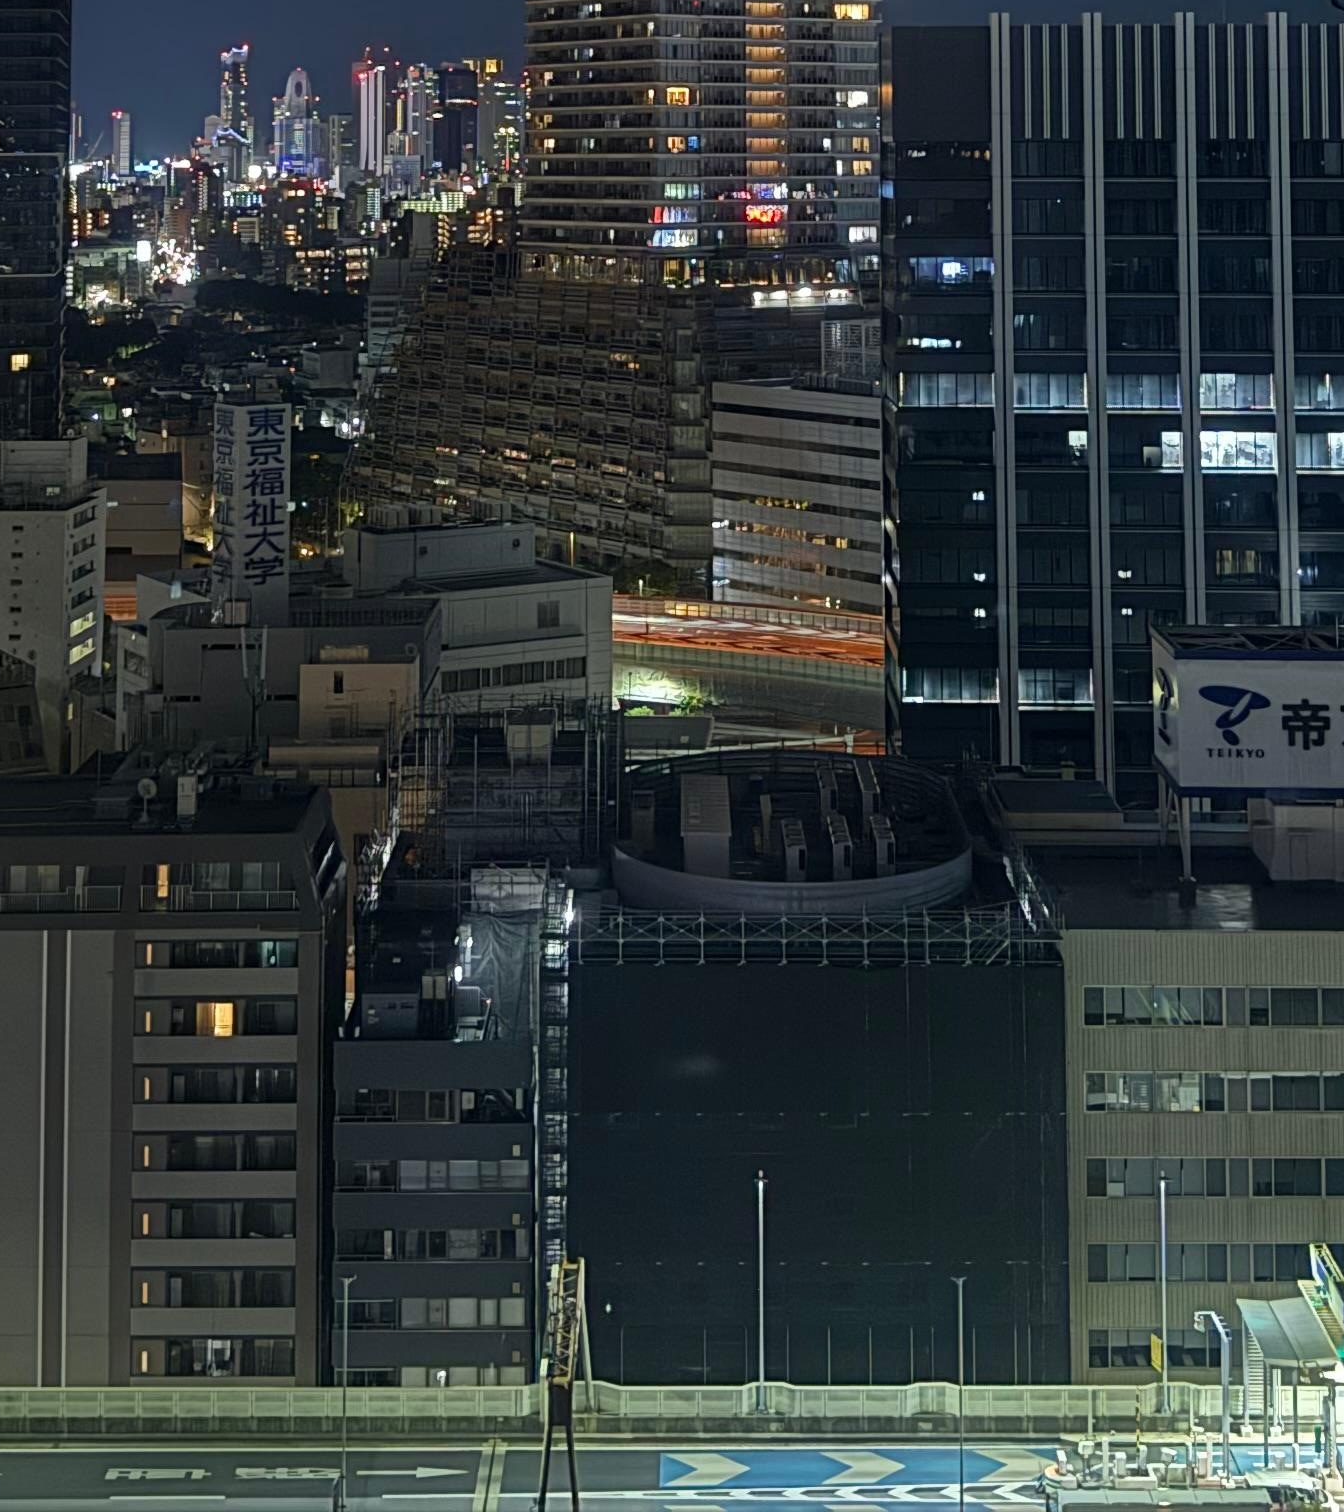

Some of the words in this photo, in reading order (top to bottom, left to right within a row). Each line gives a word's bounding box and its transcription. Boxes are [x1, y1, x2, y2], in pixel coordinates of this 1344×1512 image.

[212, 408, 236, 584] 東京福祉大学
[243, 407, 286, 585] 東京福祉大学
[1206, 747, 1265, 759] TEIKYO
